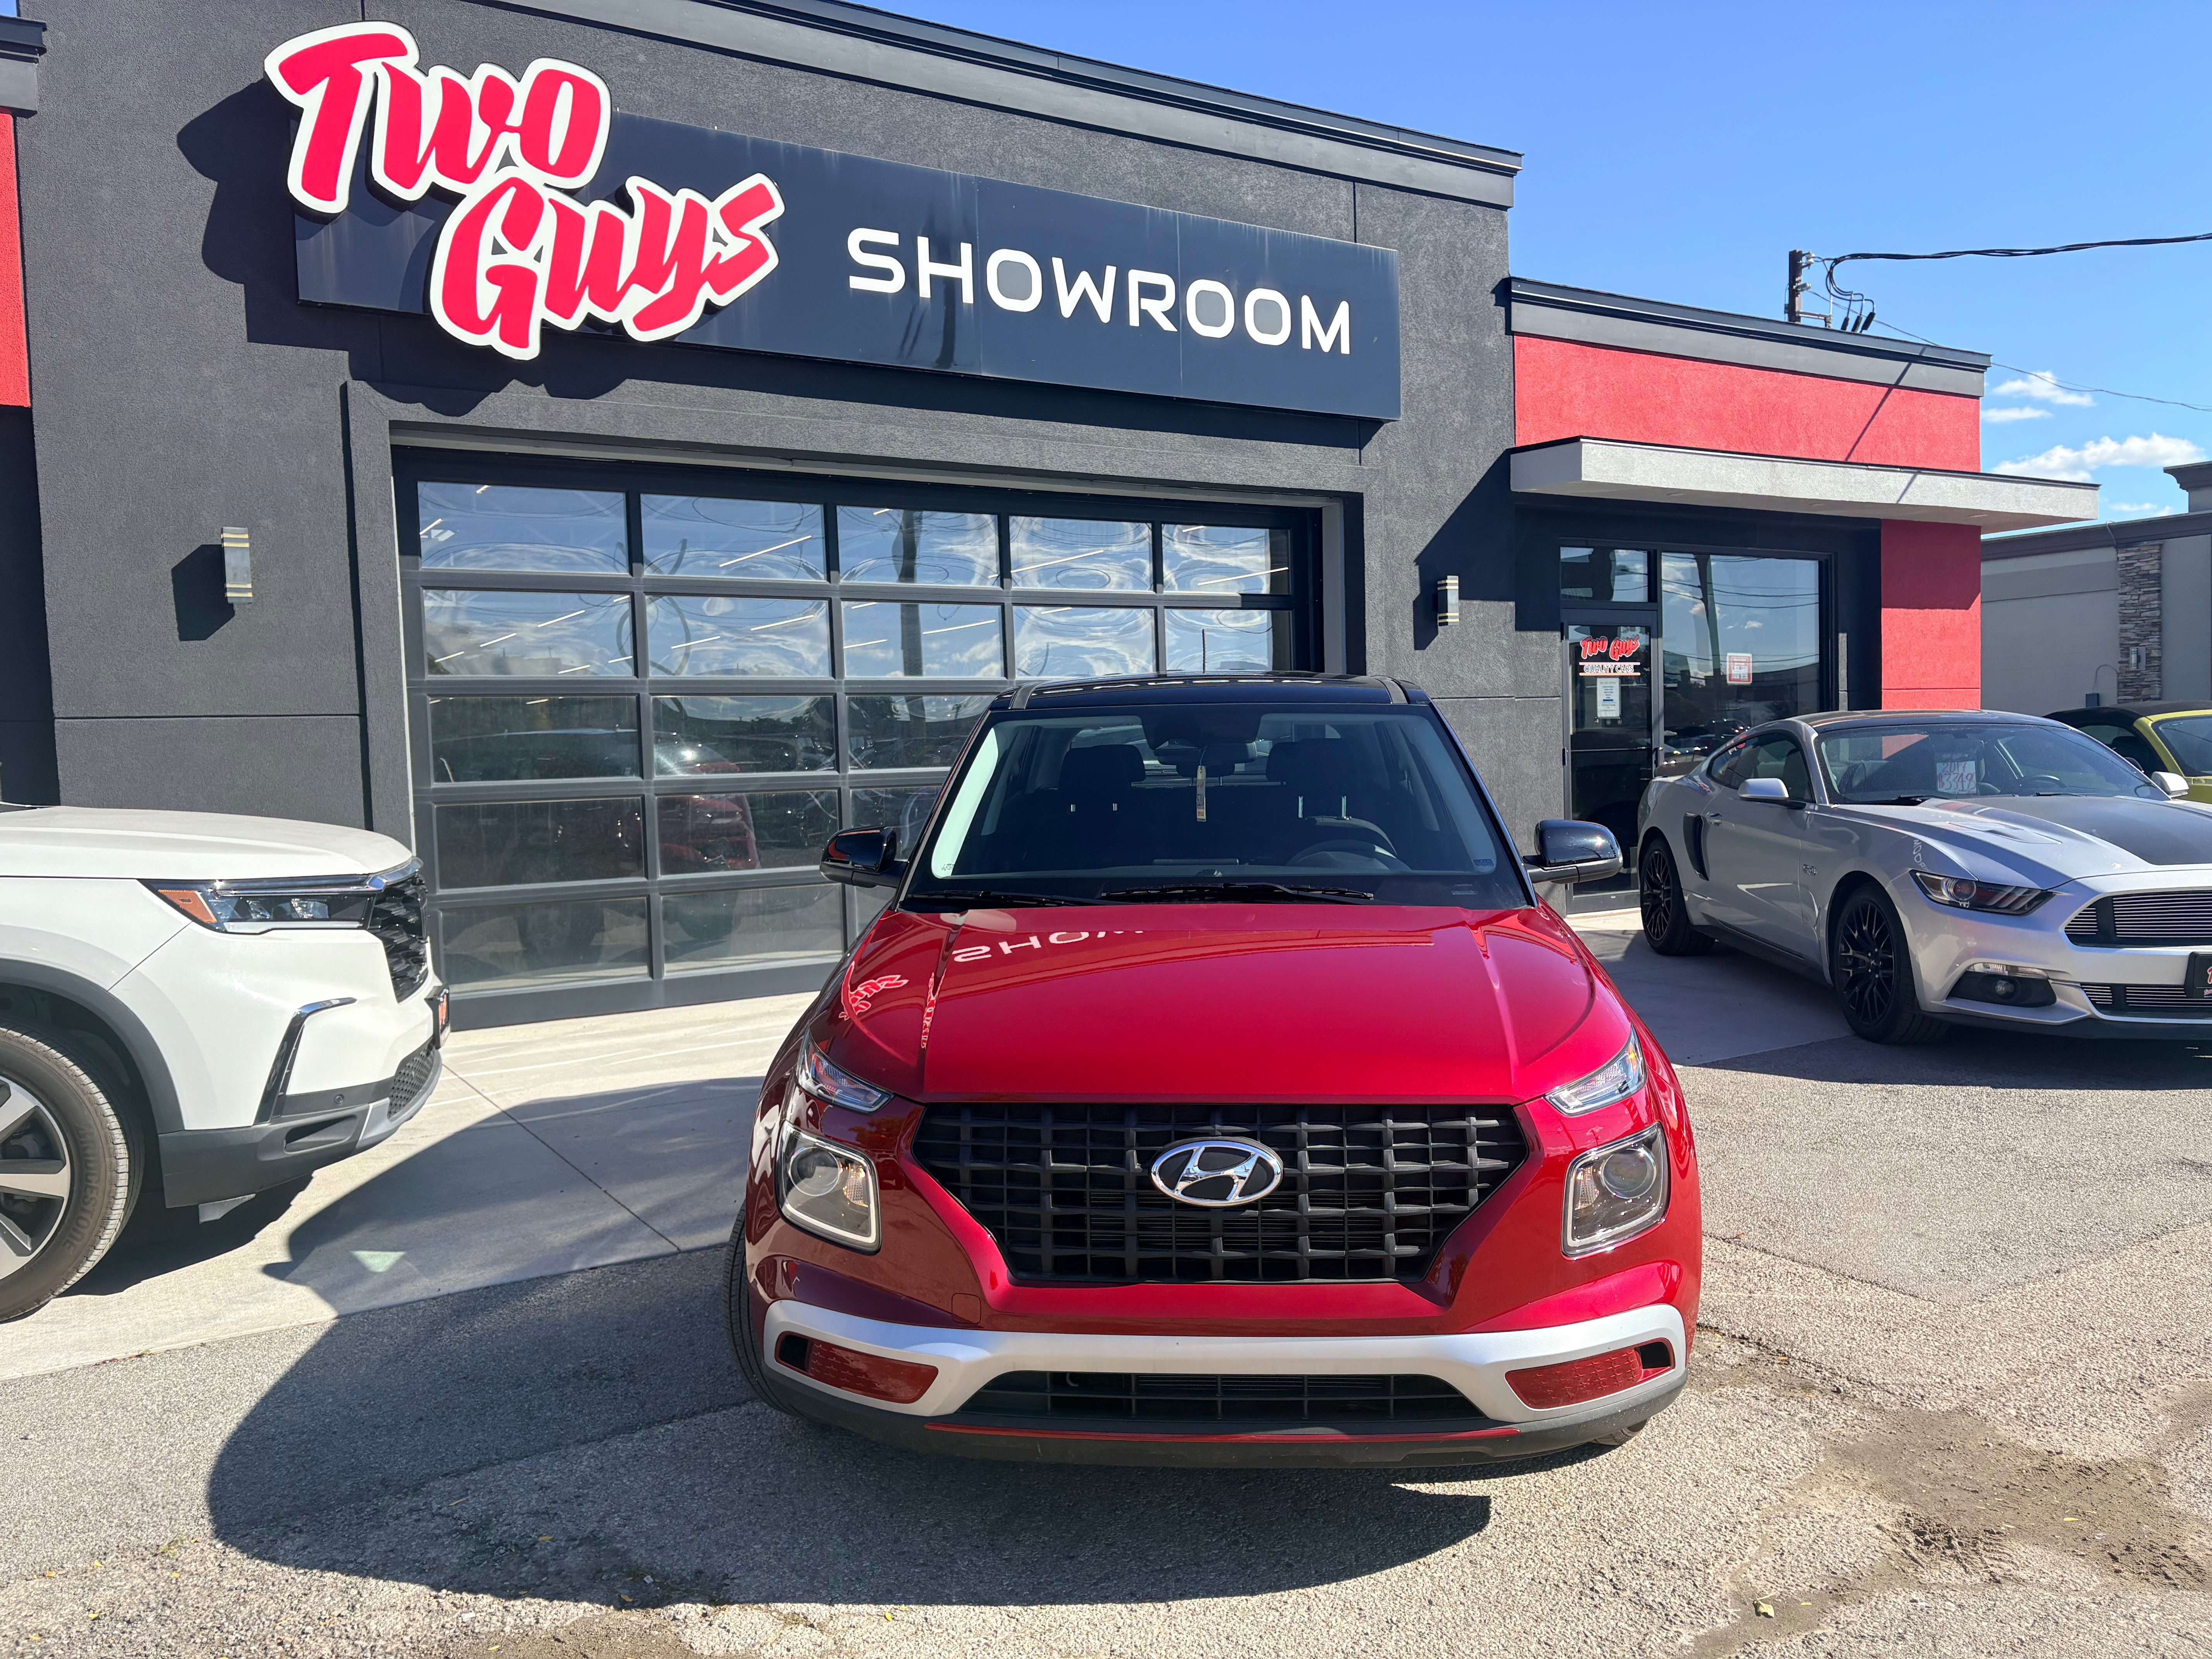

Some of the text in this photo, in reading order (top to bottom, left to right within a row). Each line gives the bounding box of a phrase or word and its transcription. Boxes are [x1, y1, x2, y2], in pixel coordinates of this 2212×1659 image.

[847, 227, 1350, 355] SHOWROOM
[1584, 665, 1634, 673] QUALITY CARS
